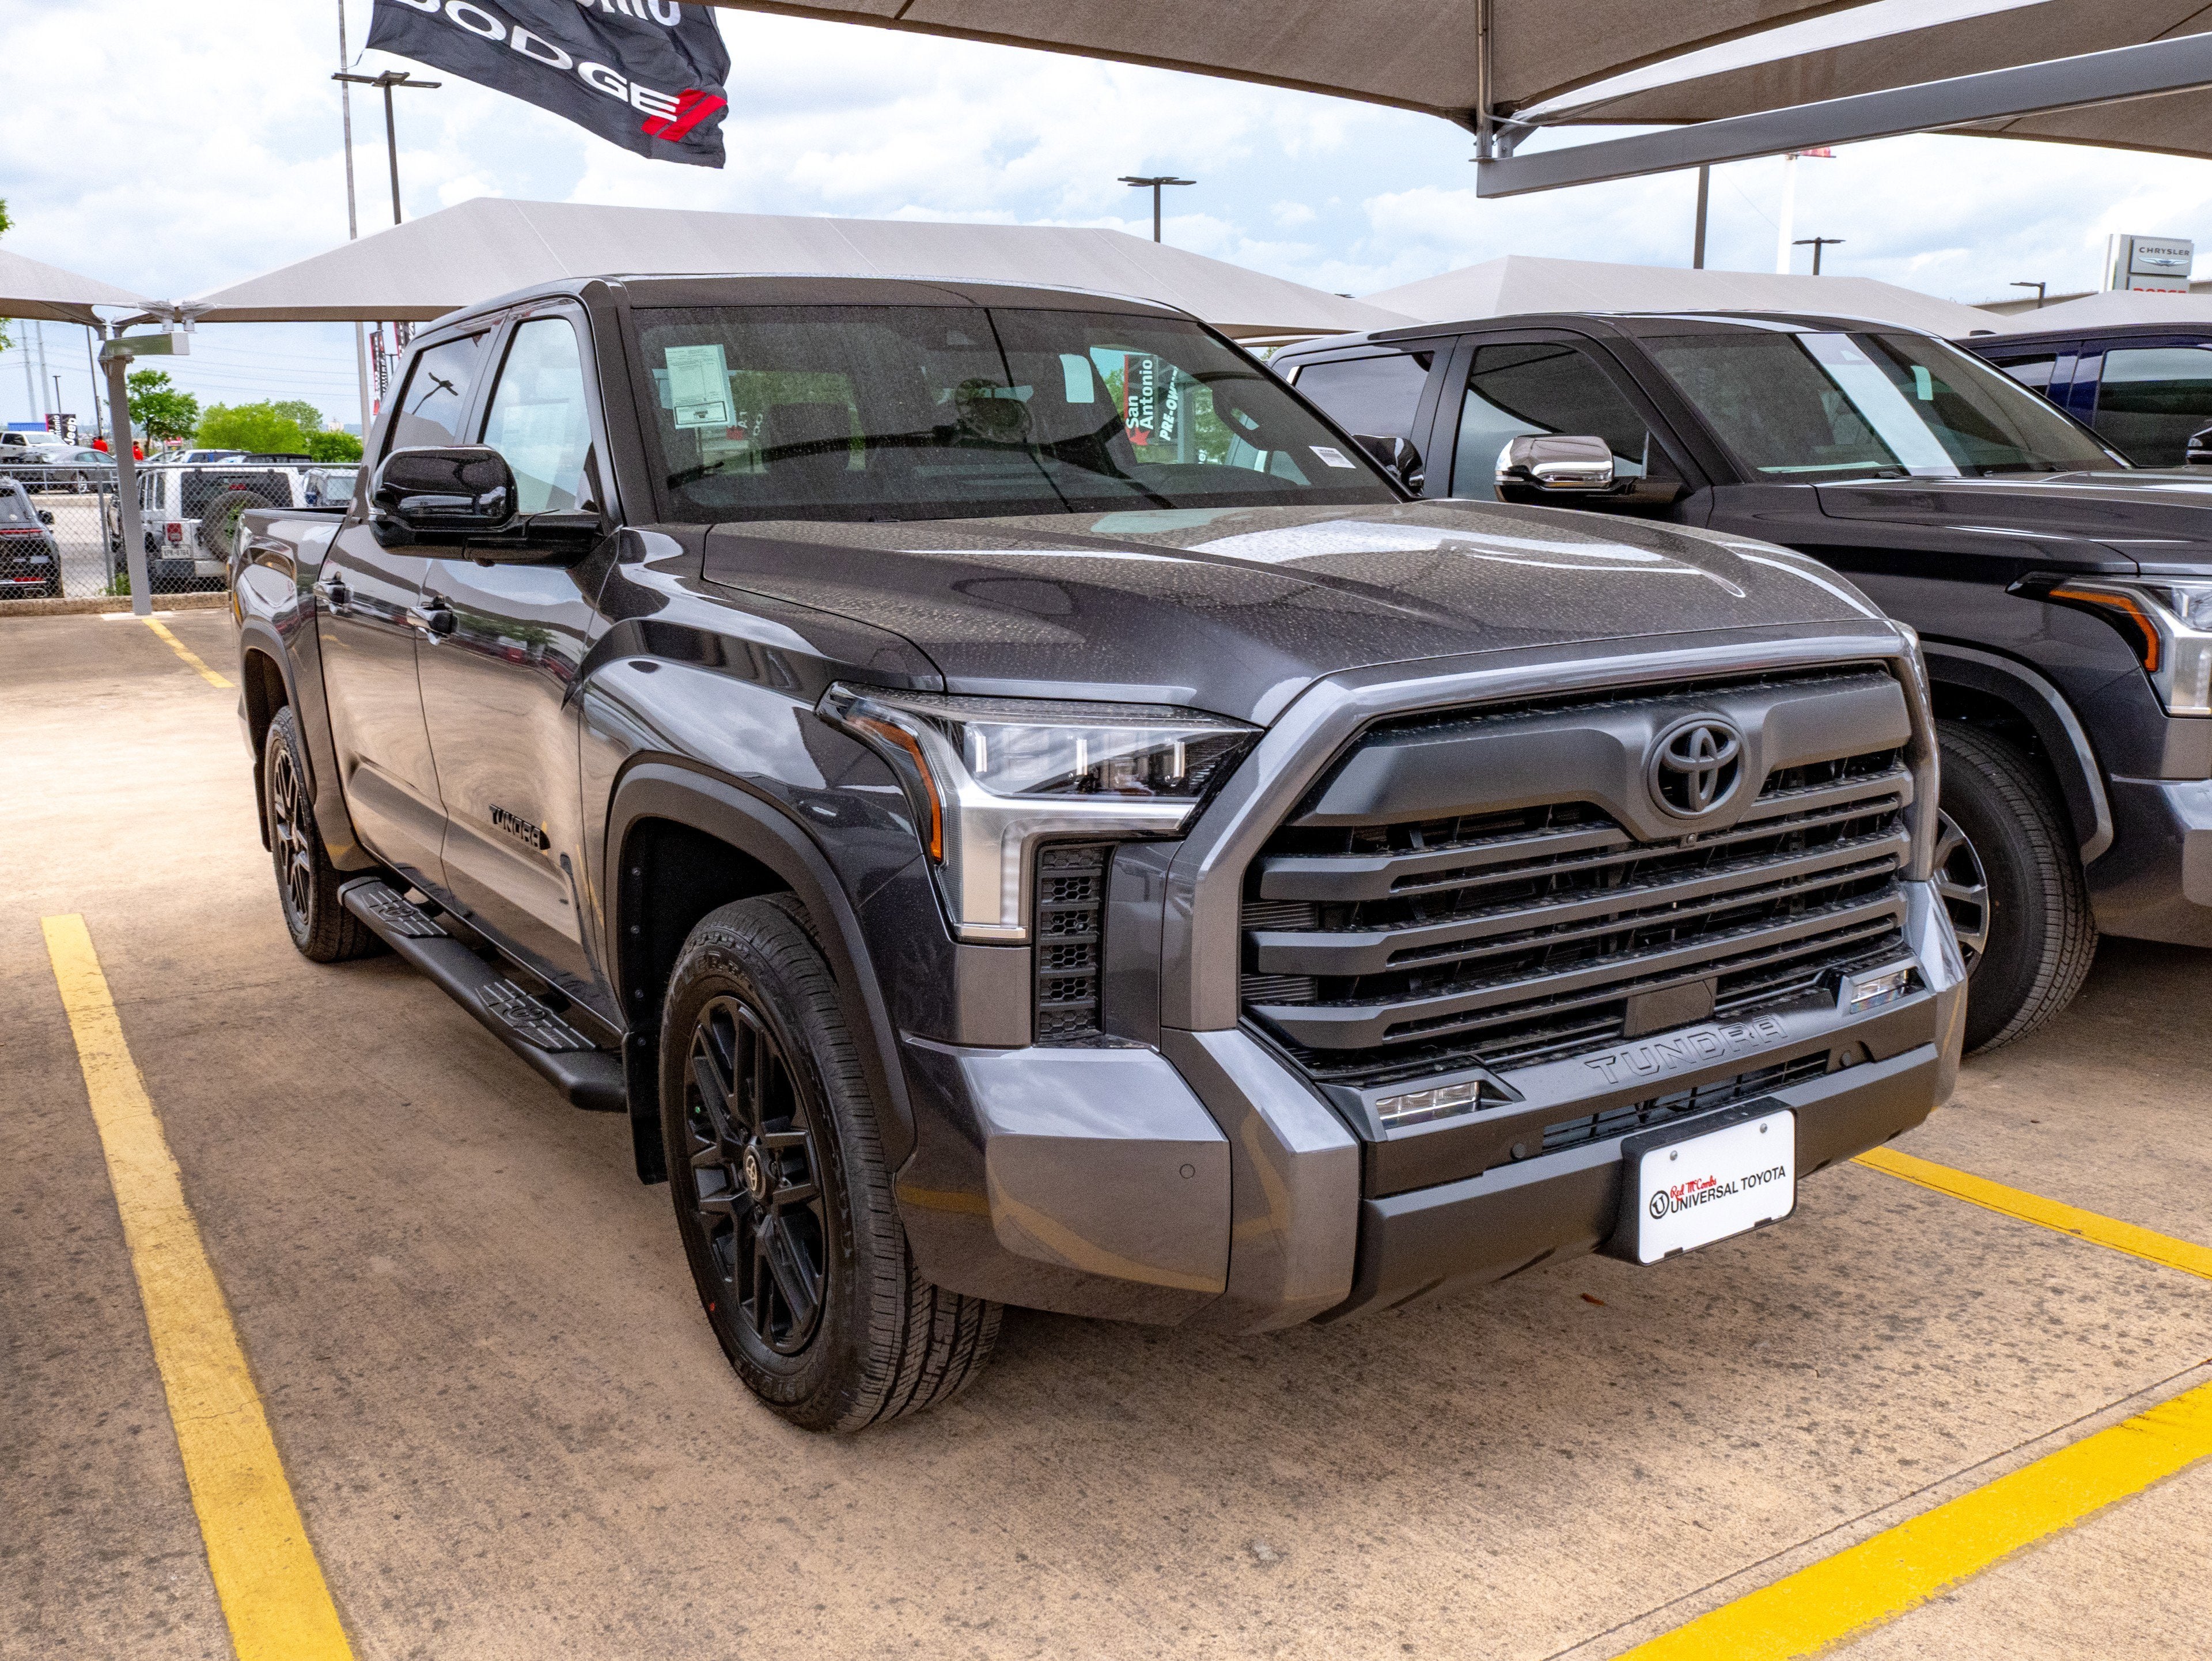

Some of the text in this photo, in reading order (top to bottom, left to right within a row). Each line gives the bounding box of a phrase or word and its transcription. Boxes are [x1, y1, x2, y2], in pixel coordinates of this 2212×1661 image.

[2139, 247, 2190, 256] CHRYSLER
[1126, 395, 1139, 429] San
[1139, 360, 1154, 430] Antonio
[63, 417, 77, 446] Jeep
[1584, 1015, 1788, 1085] TUNDRA
[1670, 1184, 1685, 1201] Red
[1671, 1166, 1786, 1213] UNIVERSAL TOYOTA
